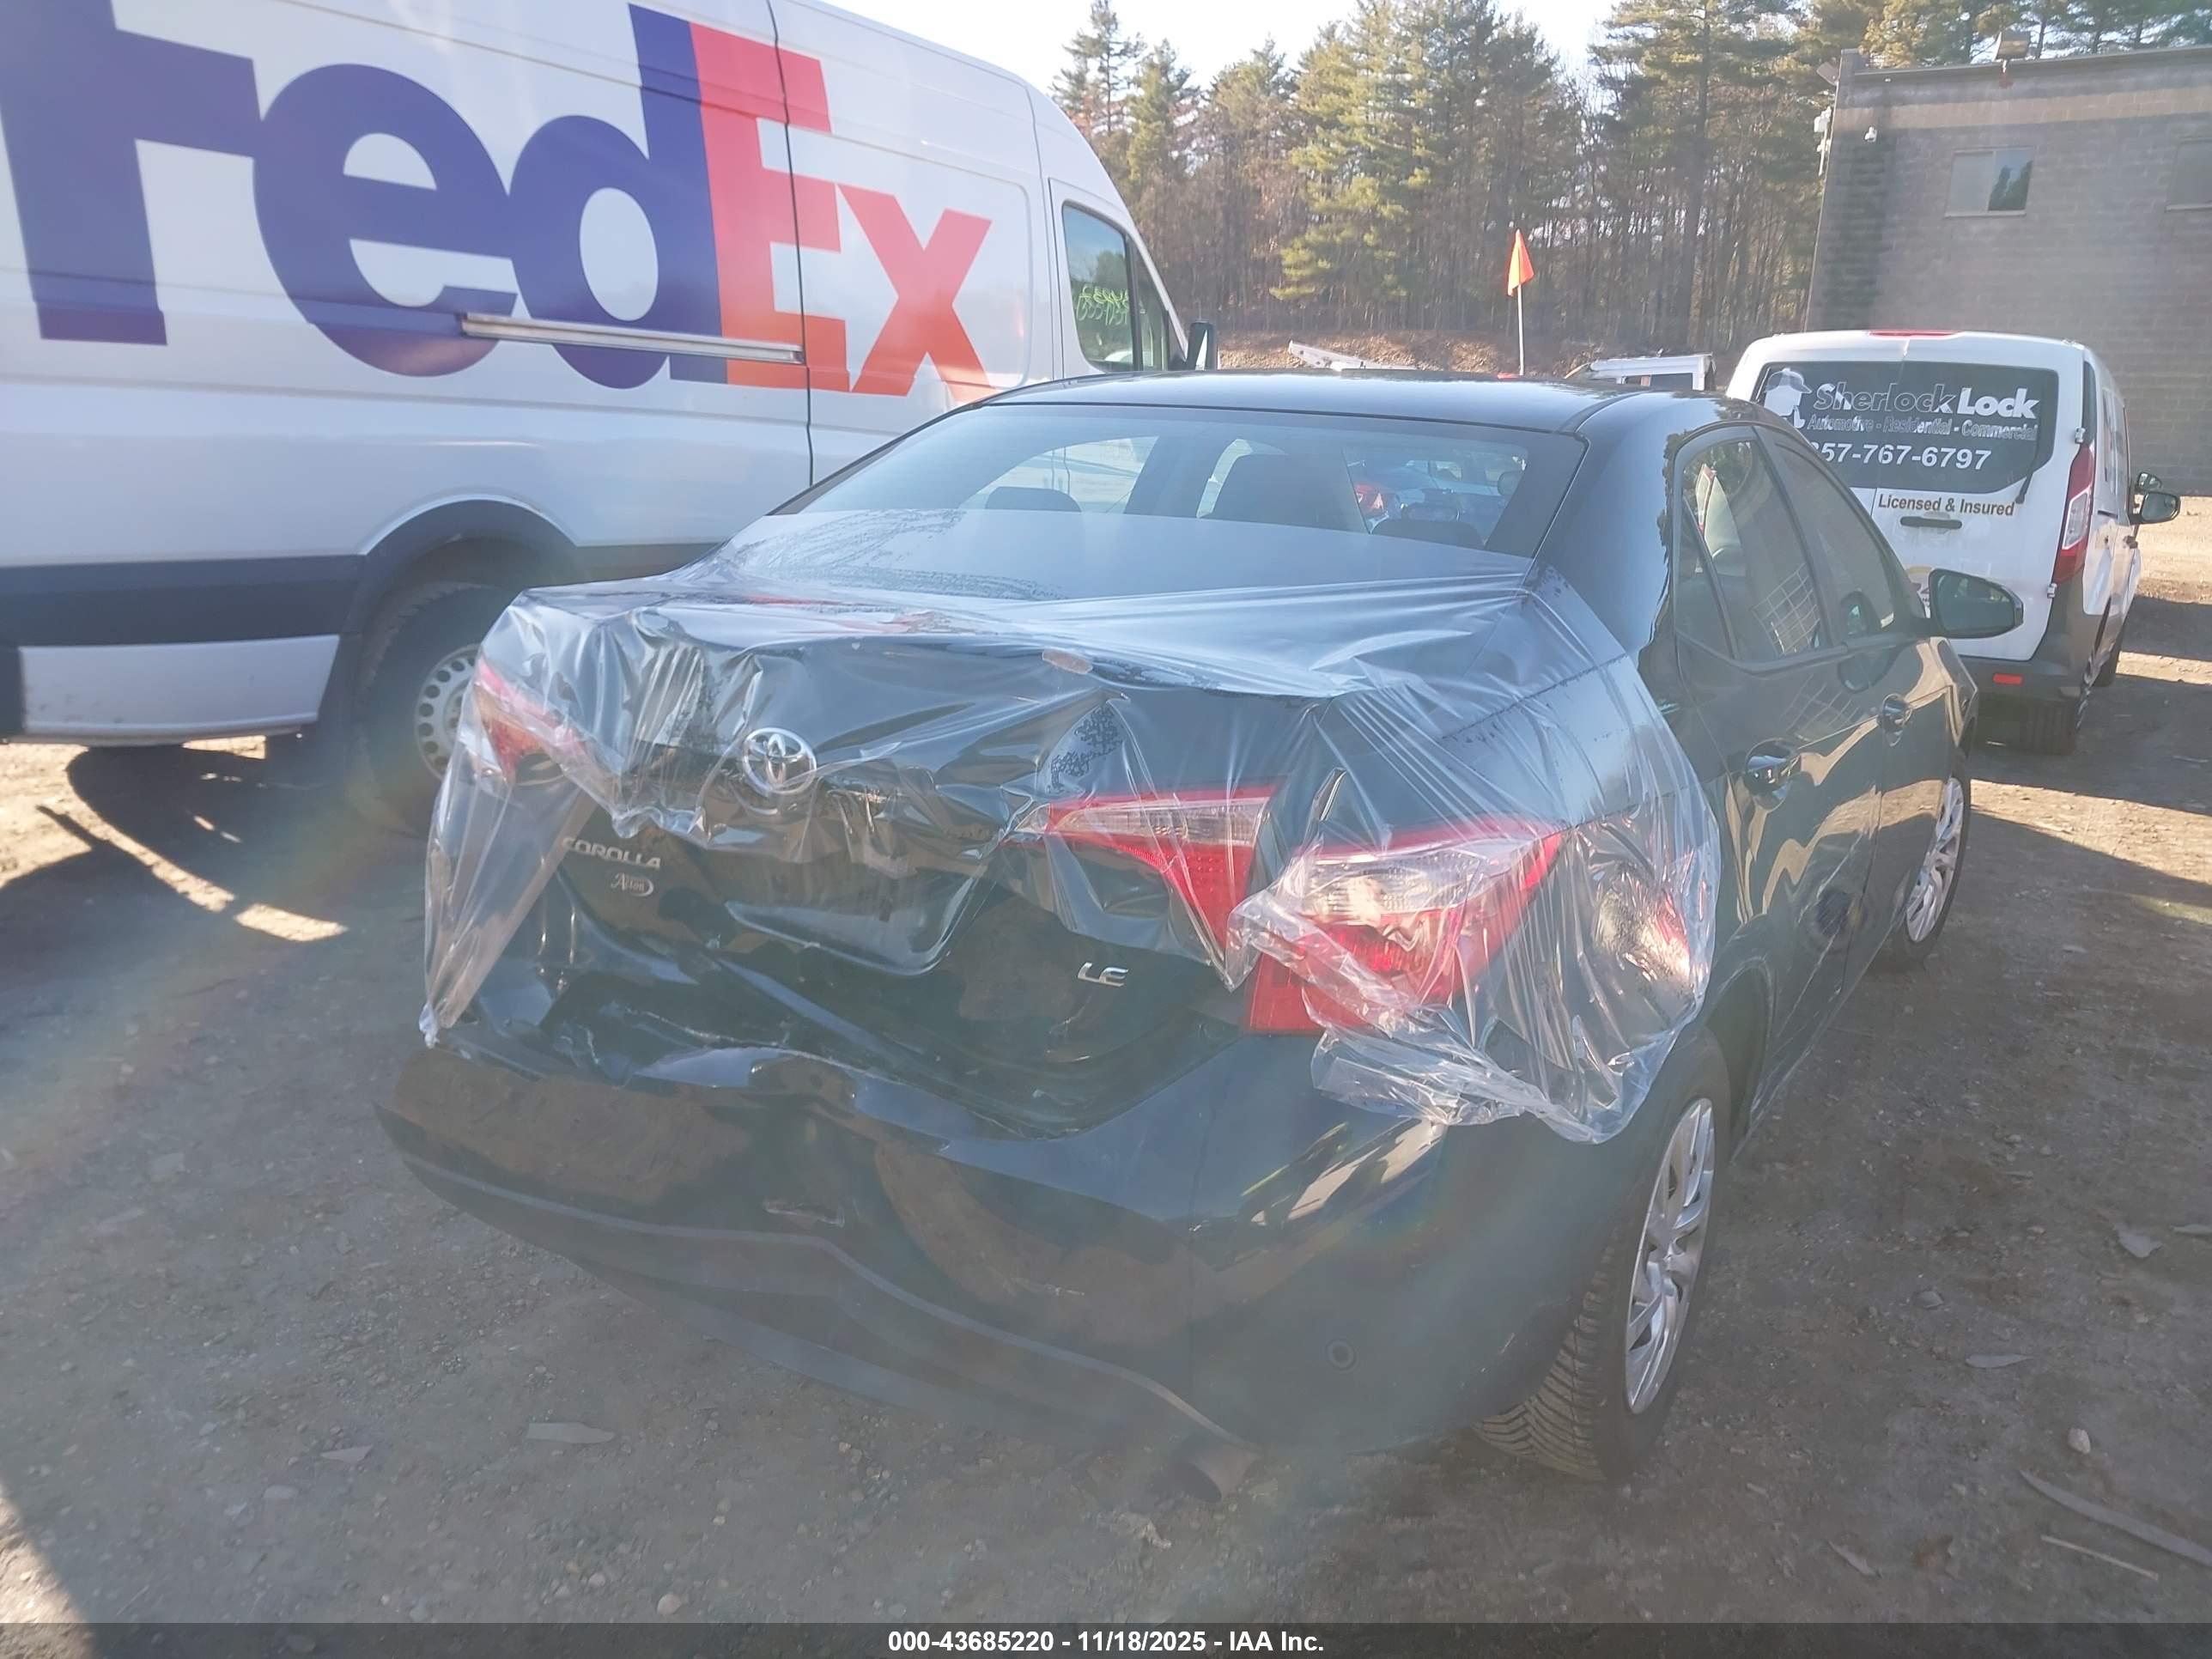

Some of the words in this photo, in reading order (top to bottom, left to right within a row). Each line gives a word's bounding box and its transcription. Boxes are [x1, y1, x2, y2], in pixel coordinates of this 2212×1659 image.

[0, 0, 994, 402] FedEx
[1813, 381, 1957, 414] Sherlock
[1956, 387, 2040, 420] Lock
[1807, 414, 1875, 433] Automotive
[1884, 416, 1954, 435] Residential
[1961, 419, 2039, 441] Commercial
[1810, 441, 1992, 471] 57-767-6797
[1878, 494, 1942, 513] Licensed
[1945, 497, 1955, 513] &
[1960, 498, 2015, 517] Insured
[562, 838, 661, 868] COROLLA
[1078, 962, 1128, 987] LE
